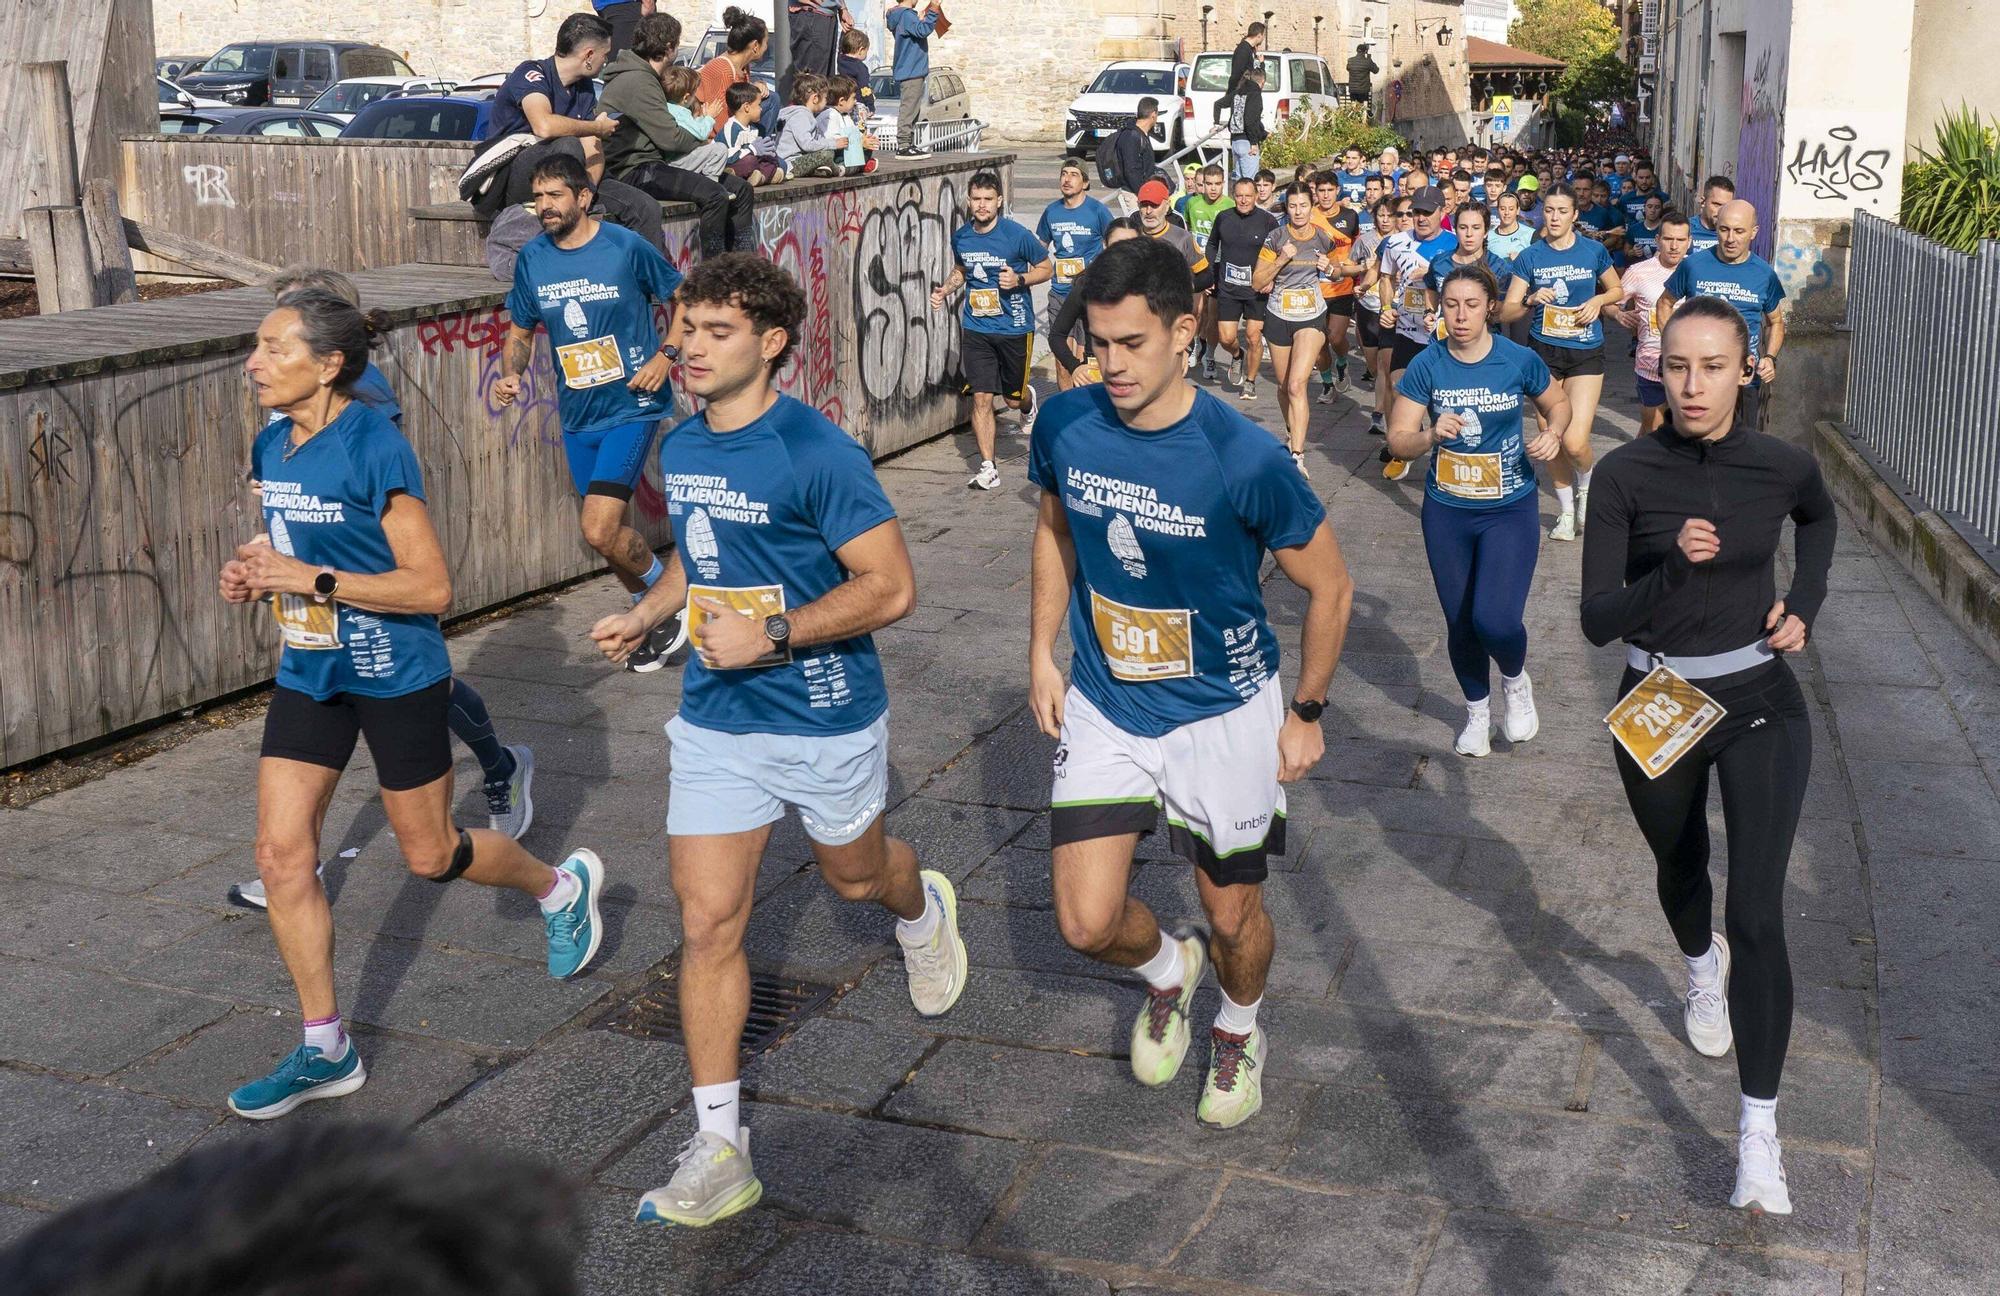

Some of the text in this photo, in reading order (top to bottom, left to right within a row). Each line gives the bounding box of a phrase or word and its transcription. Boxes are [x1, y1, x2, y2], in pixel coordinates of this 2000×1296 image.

[1541, 267, 1586, 280] ALMENDRA
[547, 278, 589, 291] CONQUISTA
[549, 283, 607, 300] ALMENDRA
[1704, 286, 1752, 296] ALMENDRA
[580, 291, 620, 303] KONKISTA
[575, 350, 604, 372] 221
[1440, 387, 1491, 398] CONQUISTA
[1442, 393, 1509, 407] ALMENDRA
[1478, 399, 1519, 413] KONKISTA
[665, 473, 674, 484] LA
[672, 474, 727, 490] CONQUISTA
[1451, 464, 1482, 482] 109
[1068, 466, 1158, 502] LA CONQUISTA
[322, 502, 342, 511] REN
[671, 486, 748, 510] ALMENDRA
[749, 501, 769, 512] REN
[1082, 487, 1185, 524] ALMENDRA
[1184, 514, 1205, 526] REN
[284, 509, 345, 523] KONKISTA
[707, 506, 771, 524] KONKISTA
[1134, 515, 1207, 538] KONKISTA
[761, 593, 776, 603] 10K
[1167, 616, 1183, 625] 10K
[1111, 620, 1159, 655] 591
[1633, 692, 1683, 738] 283
[1234, 813, 1268, 831] unbts
